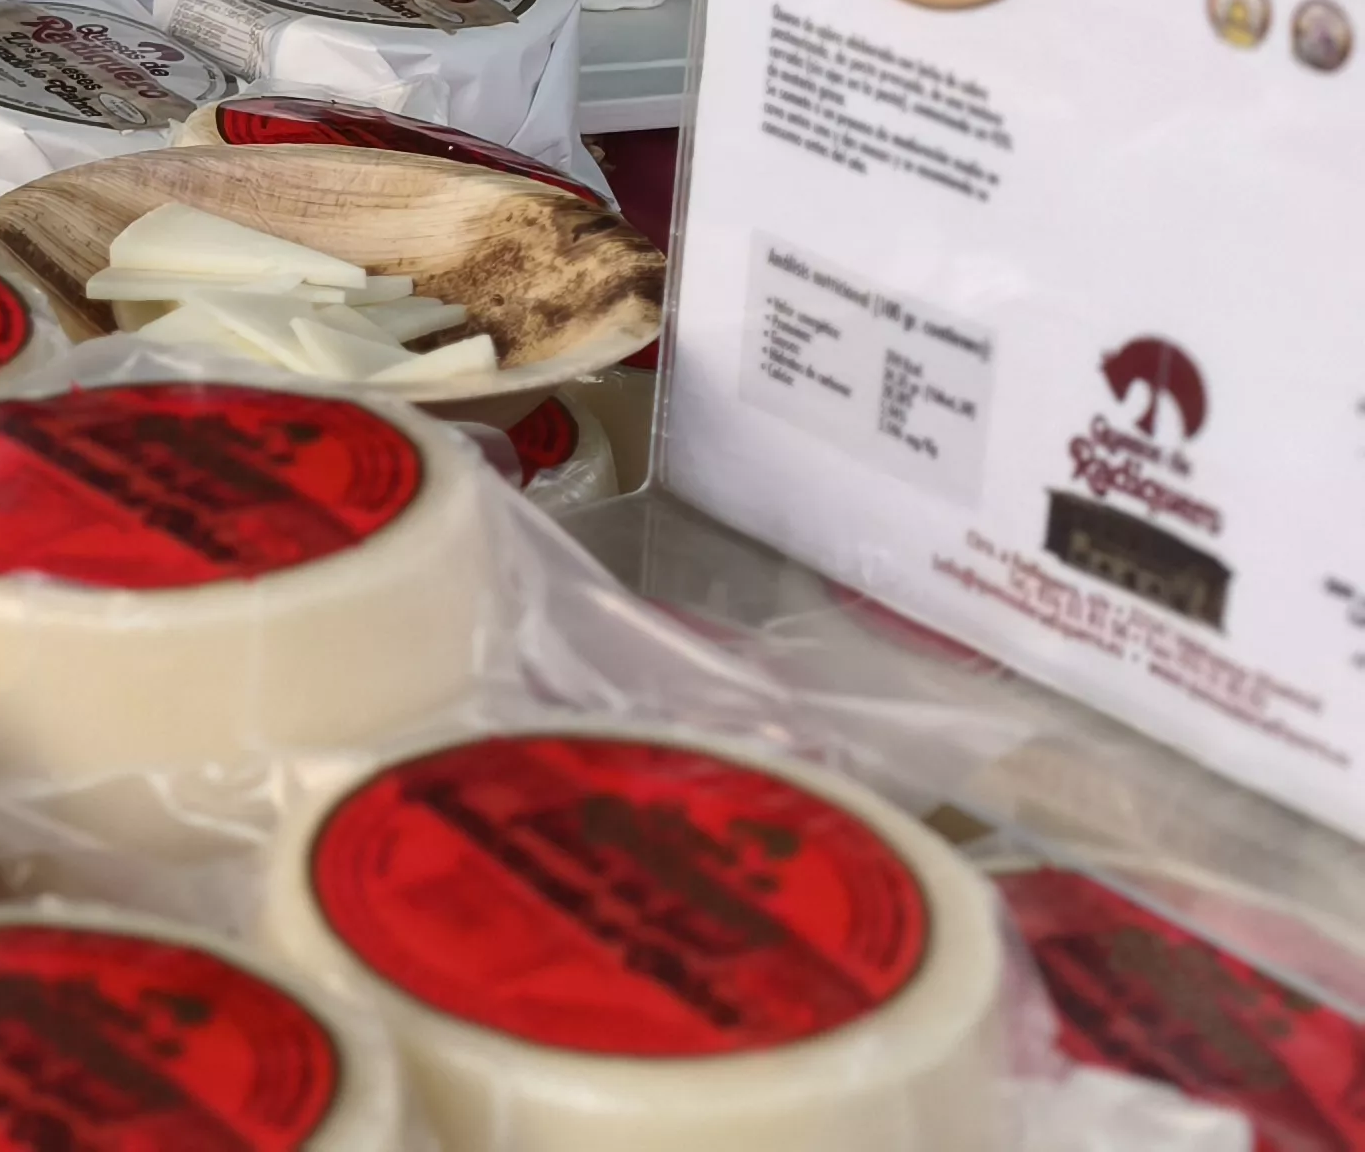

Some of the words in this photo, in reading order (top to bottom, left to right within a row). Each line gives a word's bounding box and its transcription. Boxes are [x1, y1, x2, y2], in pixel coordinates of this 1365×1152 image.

[3, 31, 41, 55] Los
[19, 15, 170, 99] Radiquero
[75, 22, 145, 60] Quesos
[140, 58, 170, 77] de
